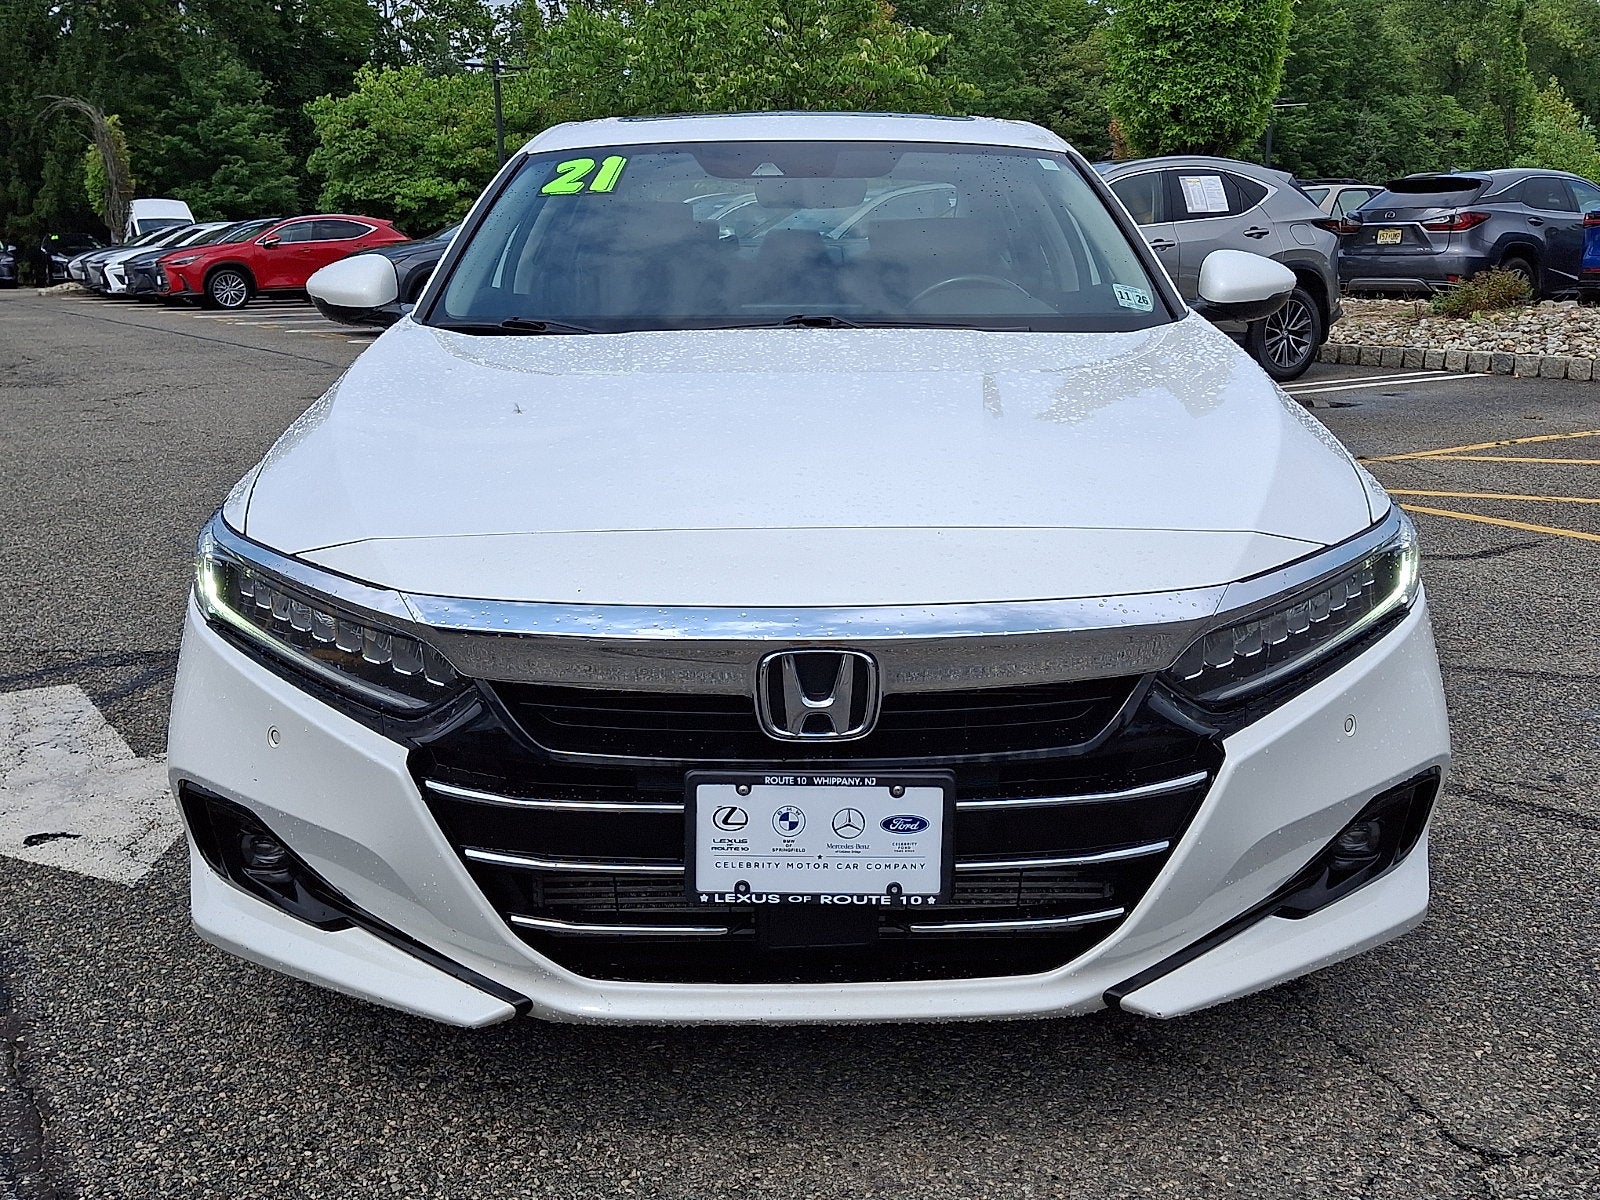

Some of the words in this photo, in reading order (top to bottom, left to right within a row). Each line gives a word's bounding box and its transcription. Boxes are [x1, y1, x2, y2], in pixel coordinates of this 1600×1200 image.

[541, 155, 627, 195] 21
[1118, 290, 1131, 301] 11
[1136, 294, 1149, 305] 26
[764, 776, 794, 785] ROUTE
[797, 777, 807, 785] 10
[864, 777, 876, 786] NJ
[889, 817, 920, 831] Ford
[715, 861, 780, 869] CELEBRITY
[786, 862, 829, 870] MOTOR
[714, 893, 781, 904] LEXUS
[788, 895, 812, 903] OF
[820, 894, 892, 905] ROUTE
[900, 895, 922, 905] 10
